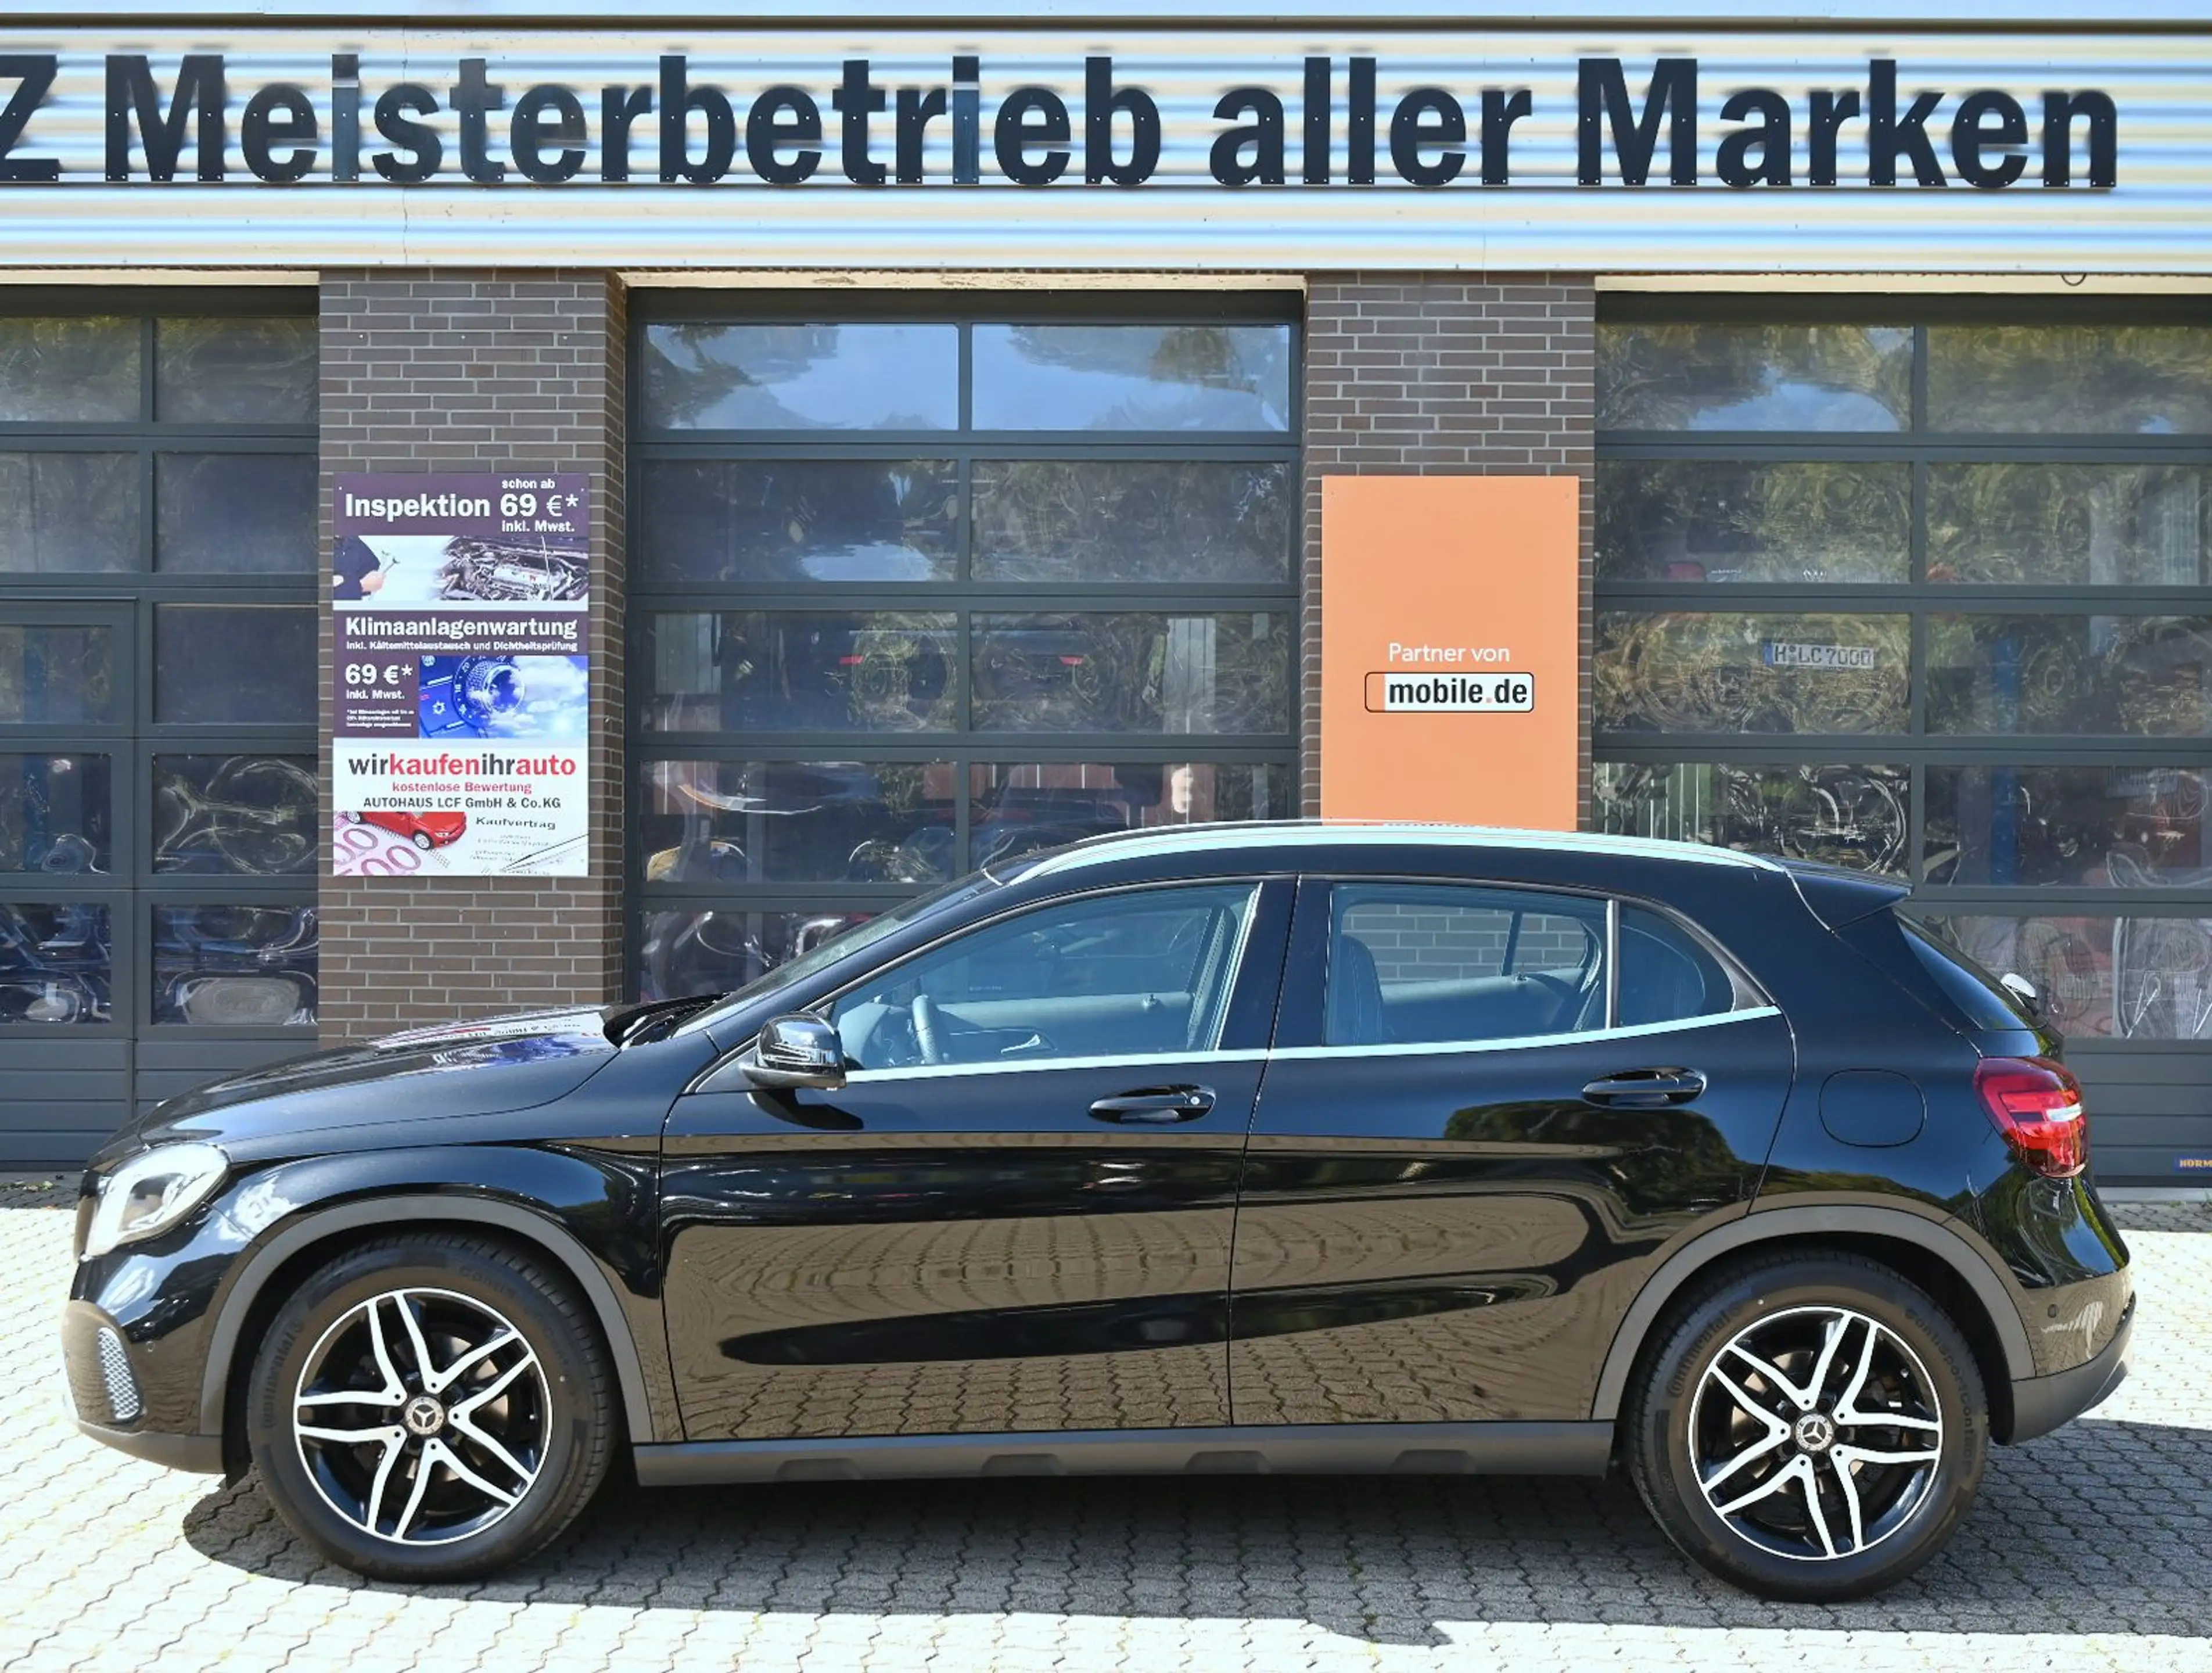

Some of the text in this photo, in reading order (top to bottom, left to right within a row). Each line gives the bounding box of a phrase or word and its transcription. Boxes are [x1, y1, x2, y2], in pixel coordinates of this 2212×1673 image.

[105, 54, 1161, 185] Meisterbetrieb
[1209, 56, 1532, 186] aller
[1578, 58, 2117, 188] Marken
[501, 478, 555, 489] schon ab
[346, 493, 490, 522] Inspektion
[500, 493, 537, 517] 69
[534, 519, 575, 532] Mwst.
[346, 616, 578, 640] Klimaanlagenwartung
[369, 640, 471, 650] Kältemittelaustausch
[473, 641, 491, 651] und
[493, 641, 578, 652] Dichtheitsprüfung
[1389, 642, 1510, 662] Partner von
[345, 663, 377, 685] 69
[372, 690, 405, 699] Mwst.
[1389, 678, 1528, 703] mobile.de
[348, 753, 576, 776] wirkaufenihrauto
[392, 782, 532, 795] kostenlose Bewertung
[363, 797, 433, 809] AUTOHAUS
[437, 797, 462, 809] LCF
[465, 797, 502, 809] GmbH
[507, 797, 516, 809] &
[476, 817, 556, 830] Kaufvertrag
